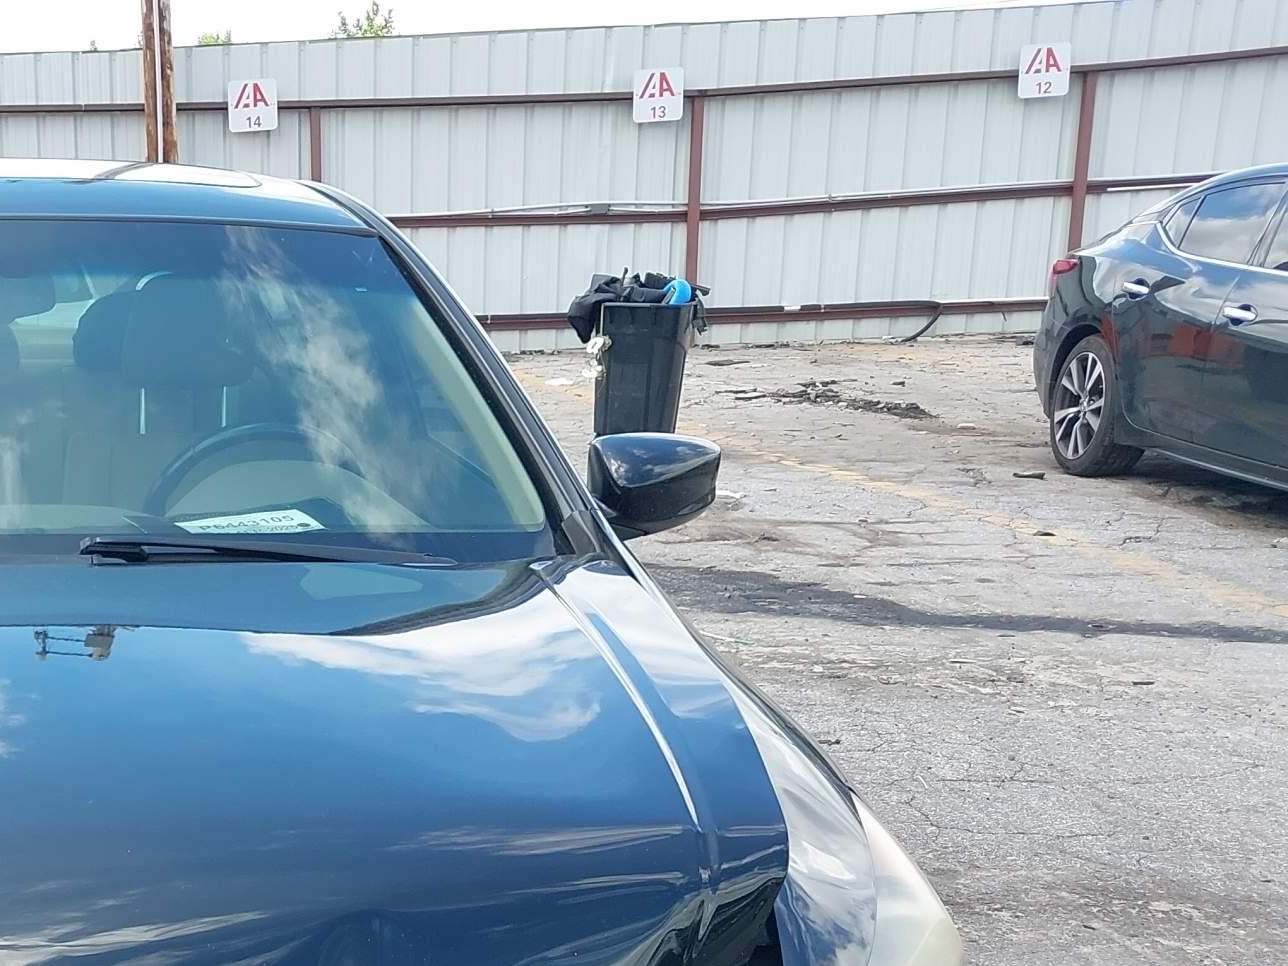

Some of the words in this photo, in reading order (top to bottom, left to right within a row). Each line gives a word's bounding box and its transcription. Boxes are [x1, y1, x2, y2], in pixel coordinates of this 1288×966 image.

[1035, 81, 1052, 94] 12
[650, 105, 666, 119] 13
[245, 115, 262, 128] 14
